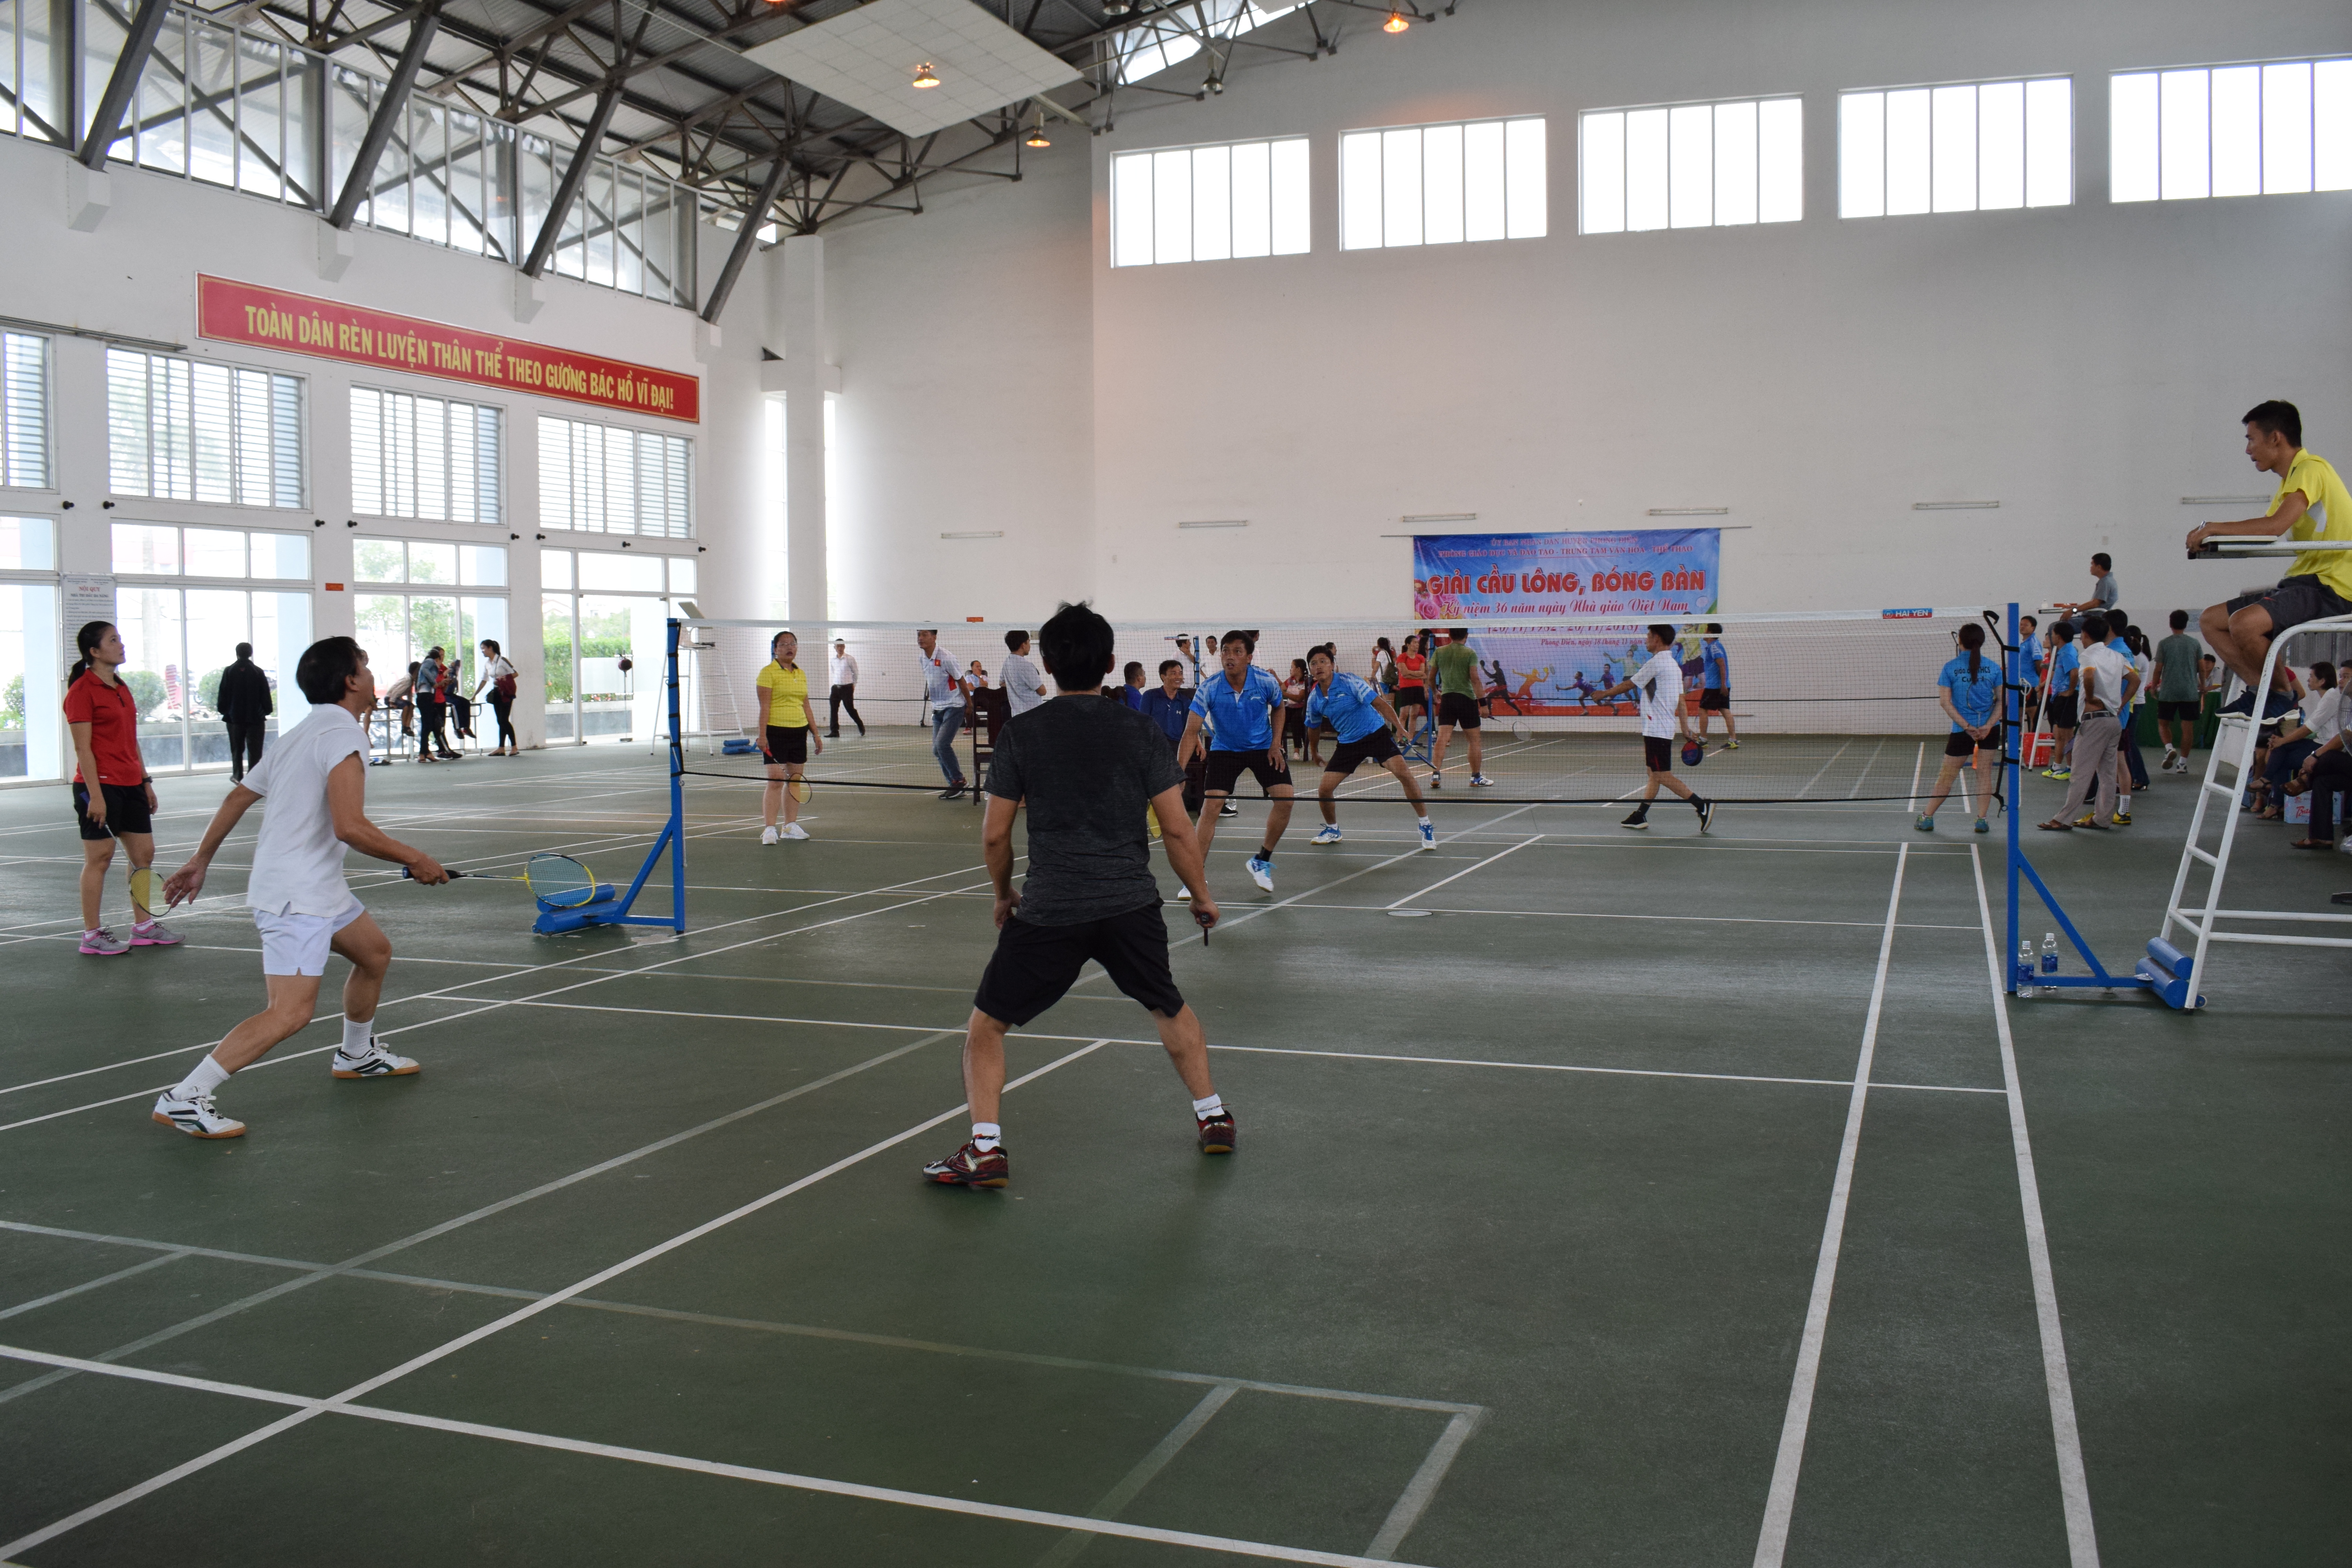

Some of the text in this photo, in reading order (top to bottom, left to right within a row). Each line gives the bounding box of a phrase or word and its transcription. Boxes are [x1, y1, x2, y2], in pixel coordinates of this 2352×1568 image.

[245, 302, 674, 413] TOÀN DÂN RÈN LUYỆN THÂN THỂ THEO GƯƠNG BÁC HỒ VĨ ĐẠI!
[1562, 536, 1588, 544] HUYỆN
[1438, 549, 1466, 557] PHÒNG
[1468, 548, 1487, 557] GIÁO
[1508, 547, 1517, 555] VÀ
[1520, 547, 1536, 555] ĐÀO
[1427, 563, 1705, 596] GIẢI CẦU LÔNG, BÓNG BÀN
[1463, 601, 1490, 617] niệm
[1494, 601, 1508, 613] 36
[1510, 603, 1535, 613] năm
[1538, 601, 1566, 615] ngày
[1569, 599, 1597, 612] Nhà
[1599, 600, 1624, 615] giáo
[1628, 598, 1655, 615] Việt
[1658, 598, 1689, 612] Nam
[1541, 639, 1559, 647] Phong
[1578, 638, 1592, 647] ngày
[1602, 638, 1619, 646] tháng
